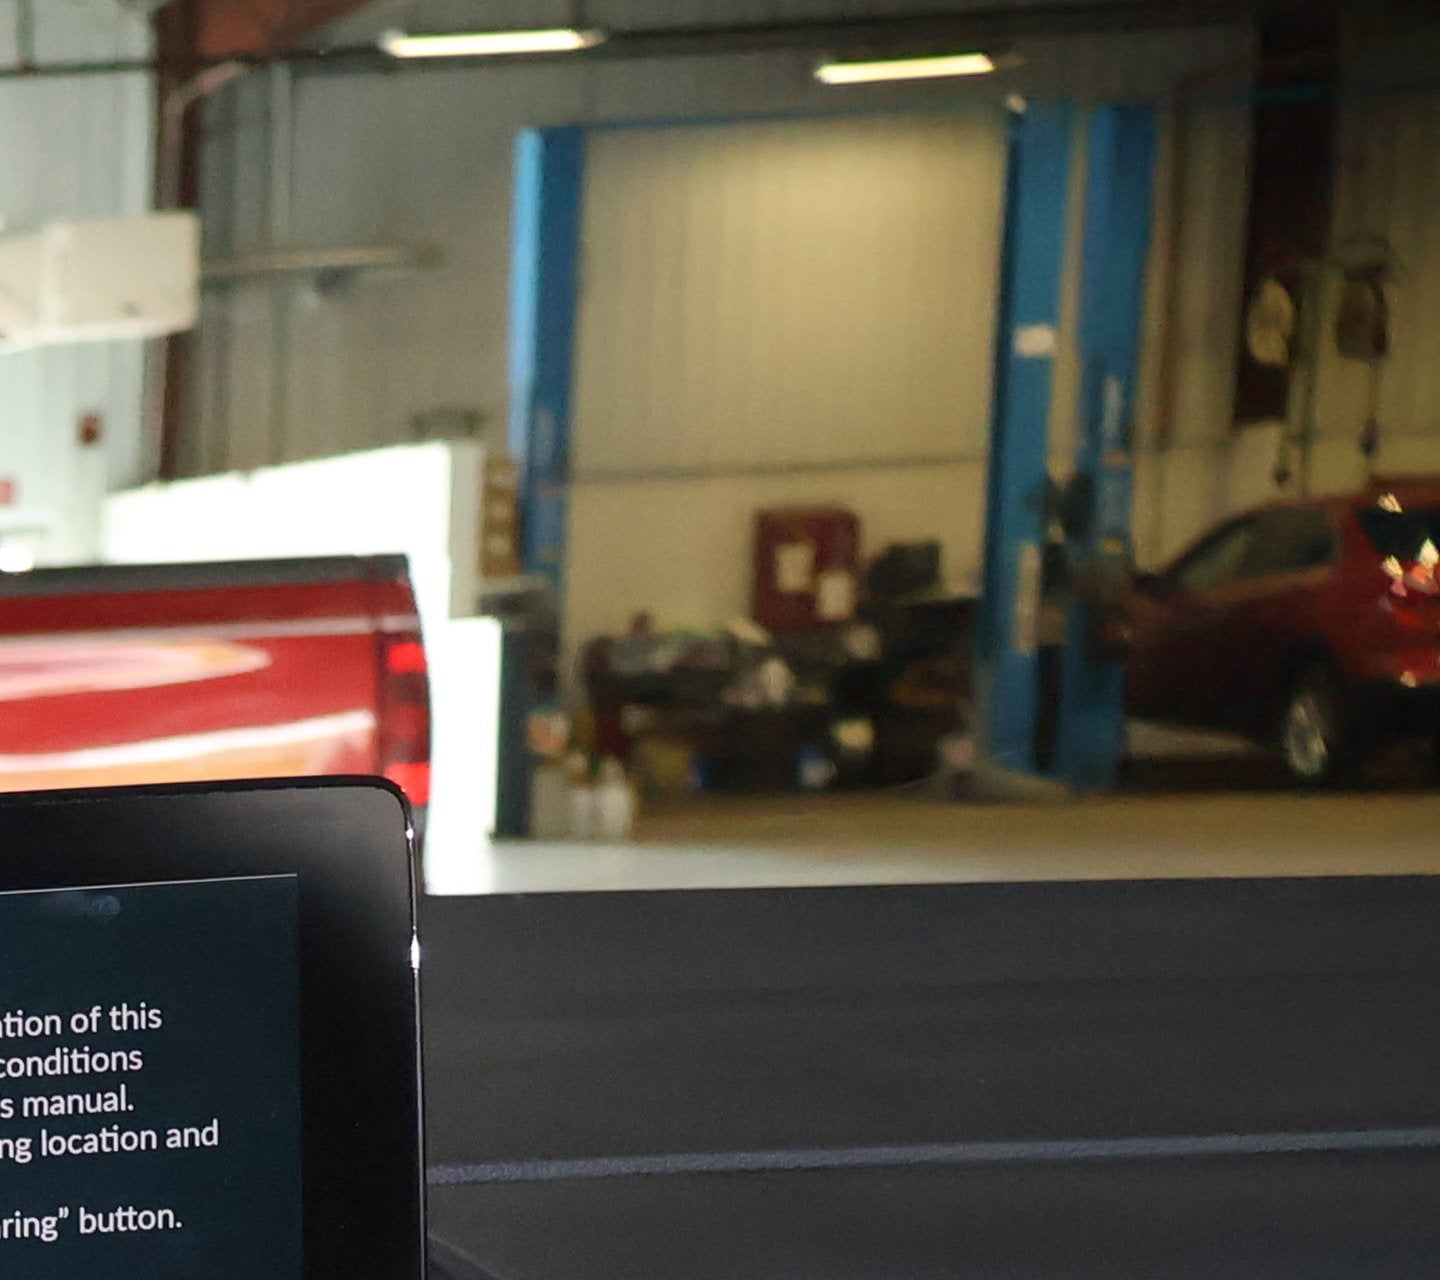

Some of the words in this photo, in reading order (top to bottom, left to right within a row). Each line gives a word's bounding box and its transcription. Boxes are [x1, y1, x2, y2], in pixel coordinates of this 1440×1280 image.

[70, 1005, 102, 1033] of
[109, 1002, 162, 1031] this
[23, 1084, 134, 1117] manual.
[41, 1124, 157, 1156] location
[166, 1118, 218, 1148] and
[79, 1206, 182, 1234] button.
